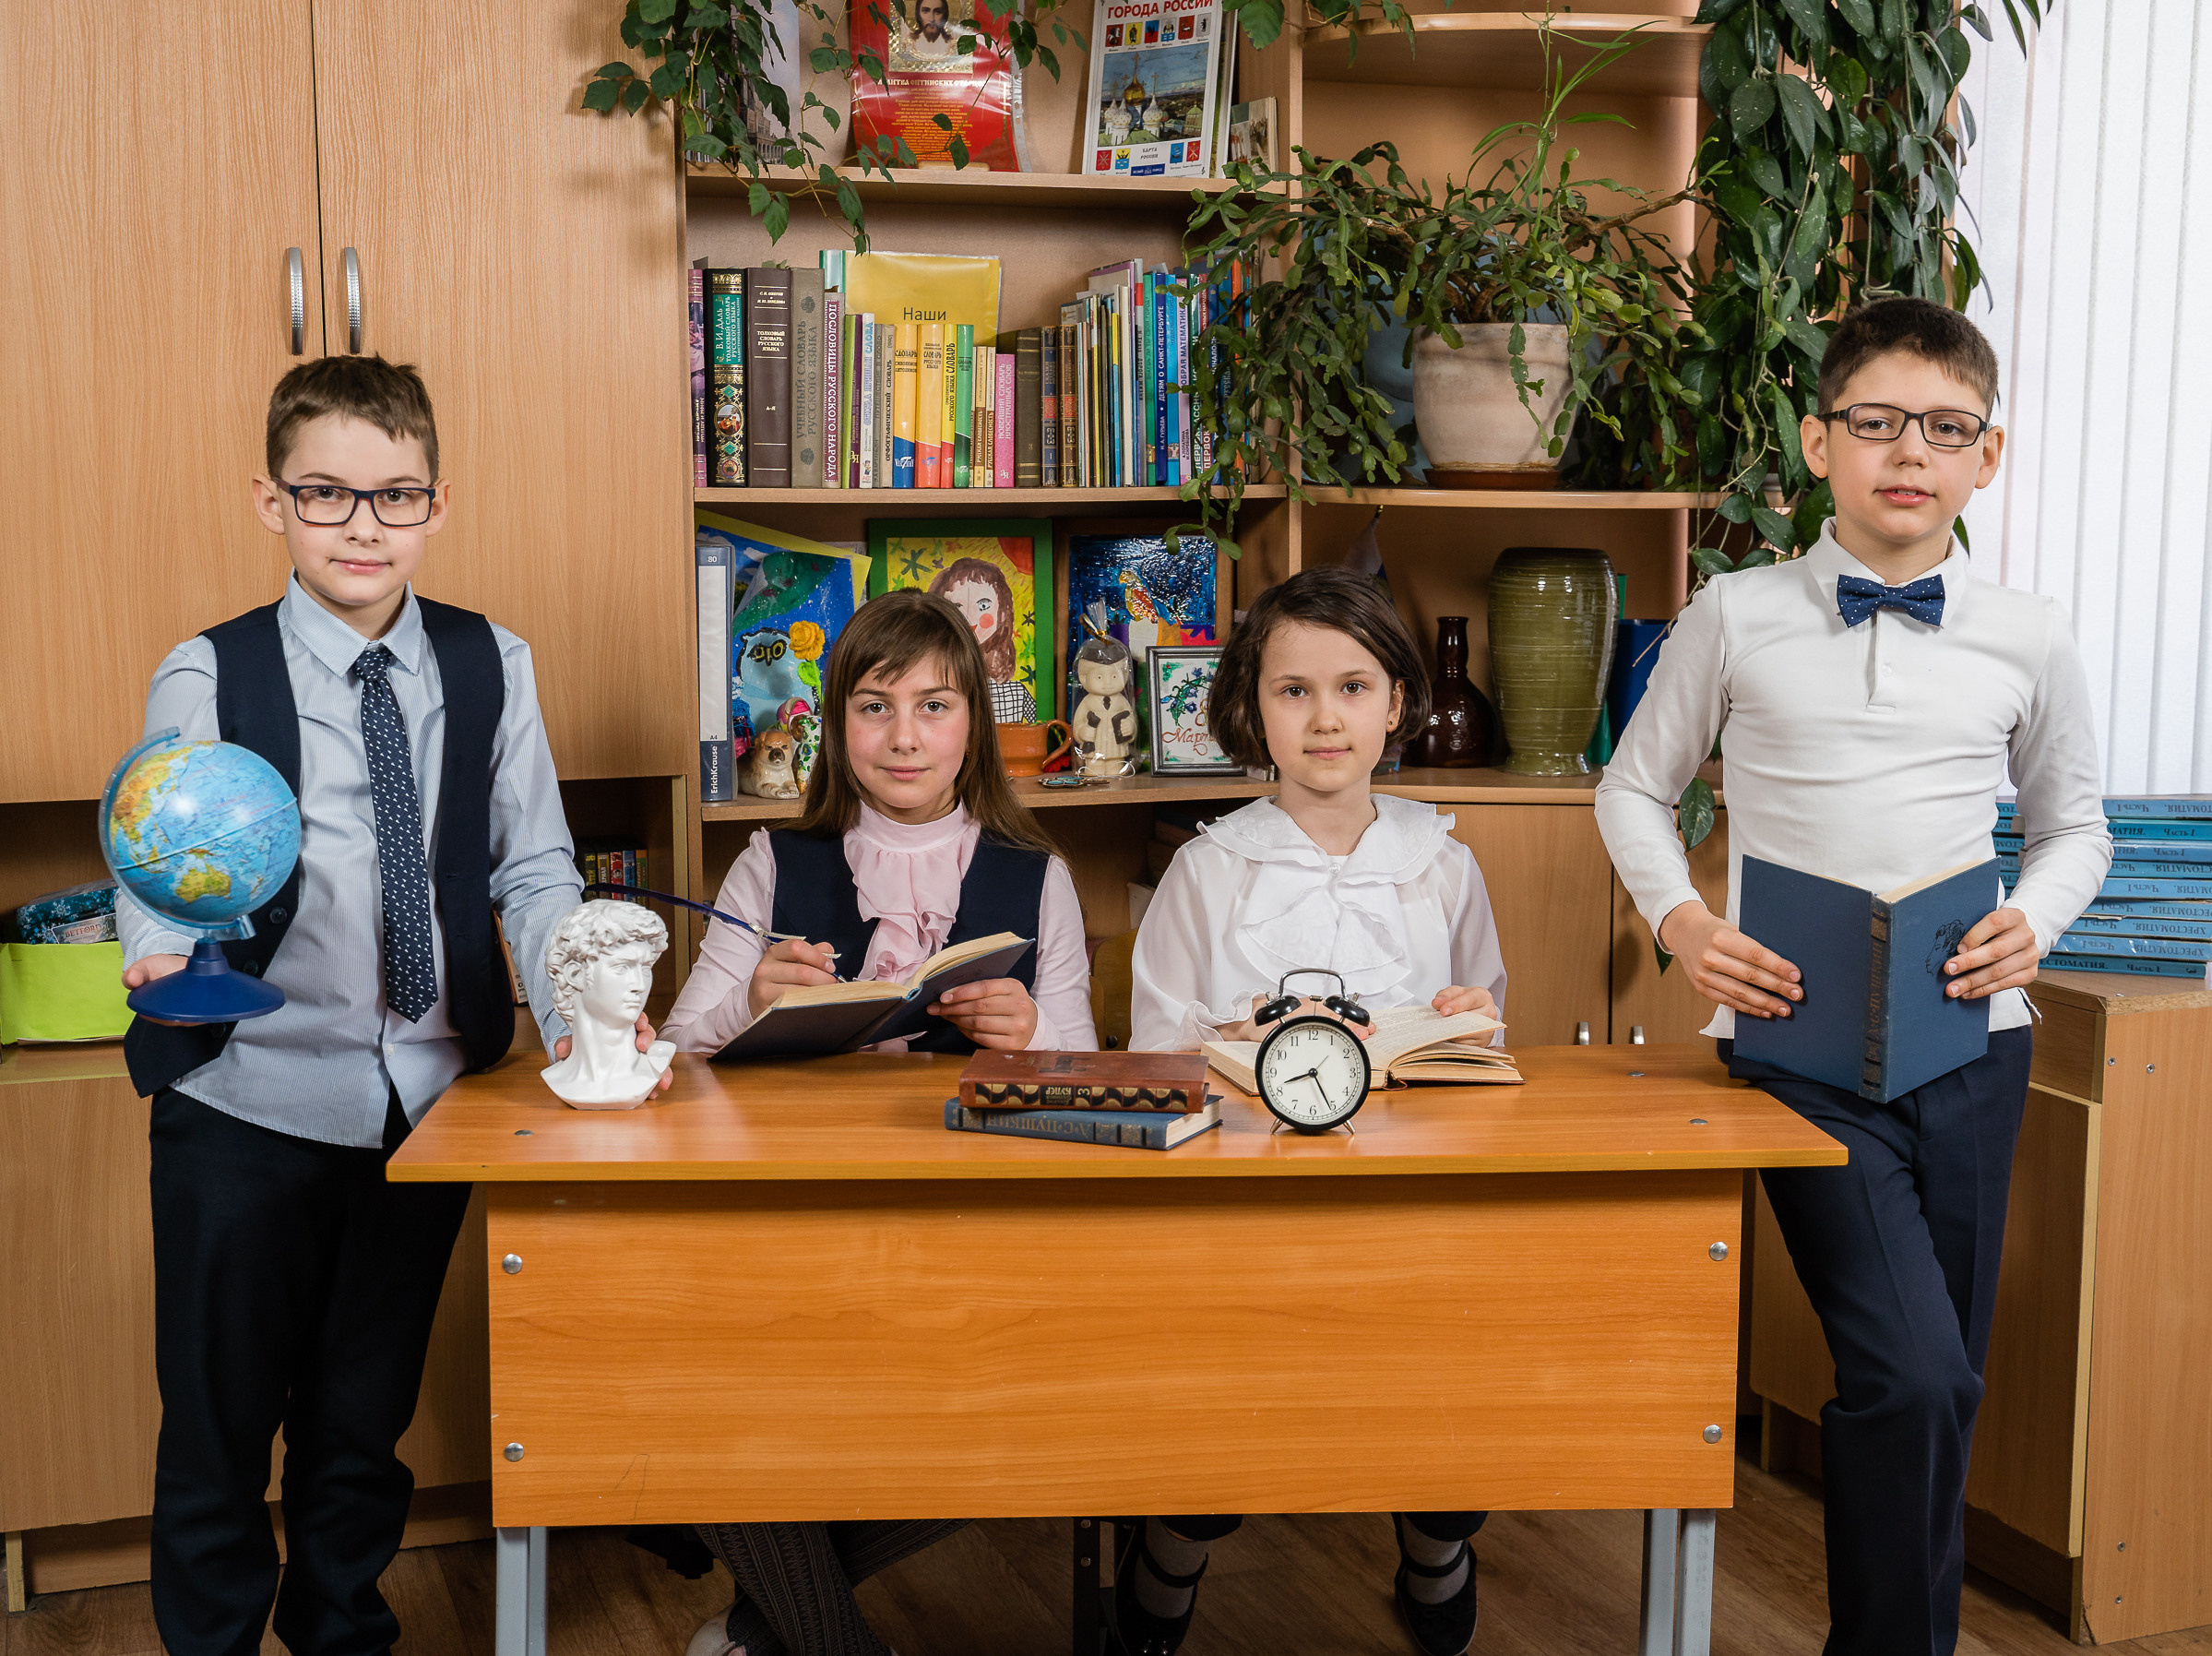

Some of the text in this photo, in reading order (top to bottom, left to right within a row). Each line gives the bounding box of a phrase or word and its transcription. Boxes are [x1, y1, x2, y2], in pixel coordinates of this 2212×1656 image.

[1108, 0, 1213, 18] ГОРОДА РОССИИ
[903, 307, 946, 321] Наши
[864, 322, 873, 354] СЛОВА
[1179, 309, 1187, 357] МАТЕМАТИК
[945, 342, 956, 374] СЛОВАРЬ
[795, 320, 807, 439] УЧЕБНЫЙ СЛОВАРЬ
[807, 326, 818, 435] РУССКОГО ЯЗЫКА
[827, 304, 838, 478] ПОСЛОВИЦЫ РУССКОГО НАРОДА
[997, 363, 1006, 440] НОВЕЙШИЙ СЛОВАРЬ
[709, 746, 718, 794] ErichKrause
[2164, 804, 2212, 814] ТОМАТИЯ.
[2152, 864, 2212, 874] СТОМАТИЯ.
[2173, 885, 2212, 895] ОМАТИЯ.
[2149, 905, 2209, 916] ЕСТОМАТИЯ.
[65, 923, 102, 938] BETFORD
[2132, 923, 2206, 935] ХРЕСТОМАТИЯ.
[2040, 959, 2109, 970] ЕСТОМАТИЯ.
[1290, 1036, 1299, 1046] 11
[1308, 1031, 1319, 1041] 12
[1330, 1035, 1335, 1046] 1
[1277, 1050, 1288, 1061] 10
[1343, 1048, 1350, 1059] 2
[1269, 1067, 1278, 1078] 9
[1350, 1067, 1357, 1078] 3
[1045, 1087, 1071, 1095] КУПЕР
[1276, 1087, 1284, 1097] 8
[1342, 1086, 1350, 1096] 4
[1291, 1100, 1299, 1110] 7
[1309, 1105, 1317, 1115] 6
[1330, 1101, 1337, 1111] 5
